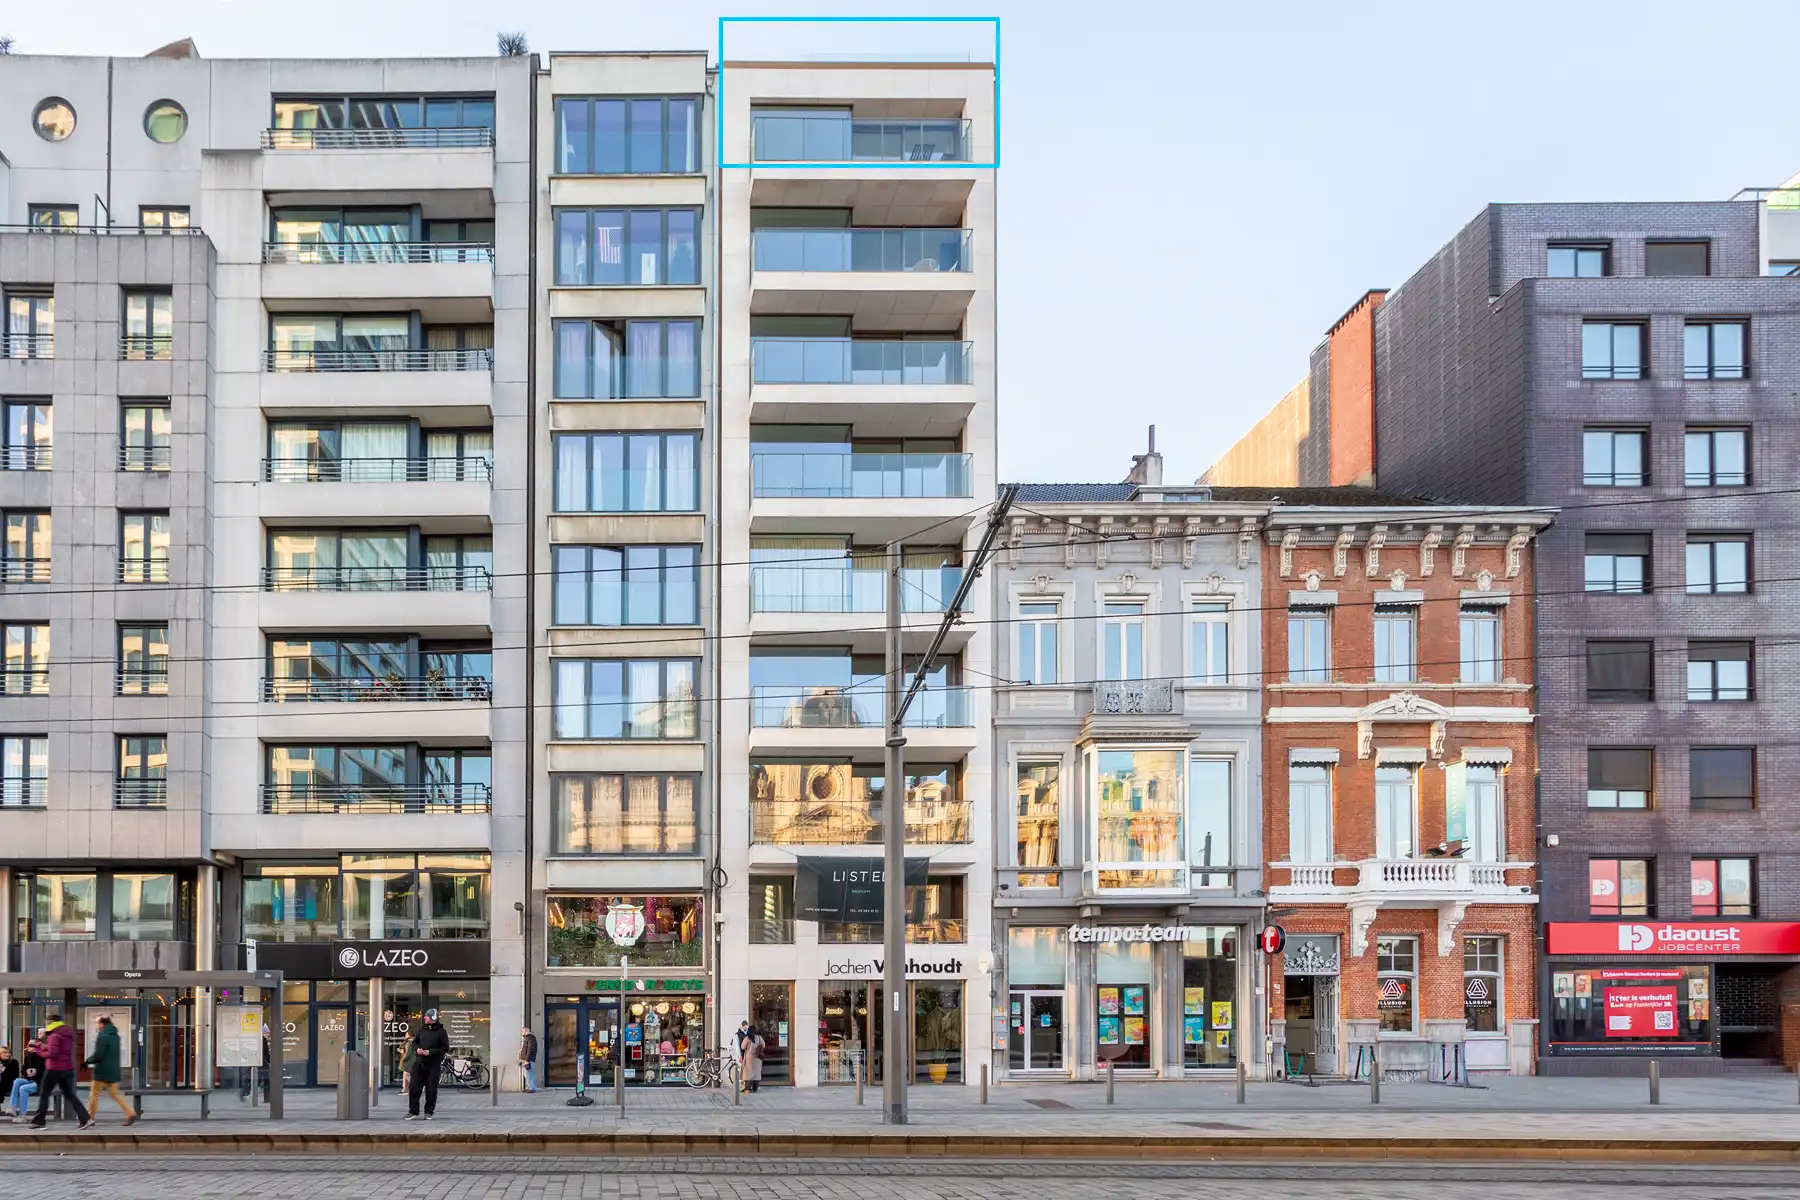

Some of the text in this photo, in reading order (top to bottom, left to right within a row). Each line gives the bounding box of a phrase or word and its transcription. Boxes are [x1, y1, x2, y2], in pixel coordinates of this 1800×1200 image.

[833, 871, 885, 882] LISTE
[1657, 925, 1740, 940] daoust
[363, 949, 429, 967] LAZEO
[824, 958, 962, 976] Jochen Vhoudt
[367, 1021, 409, 1033] ZEO
